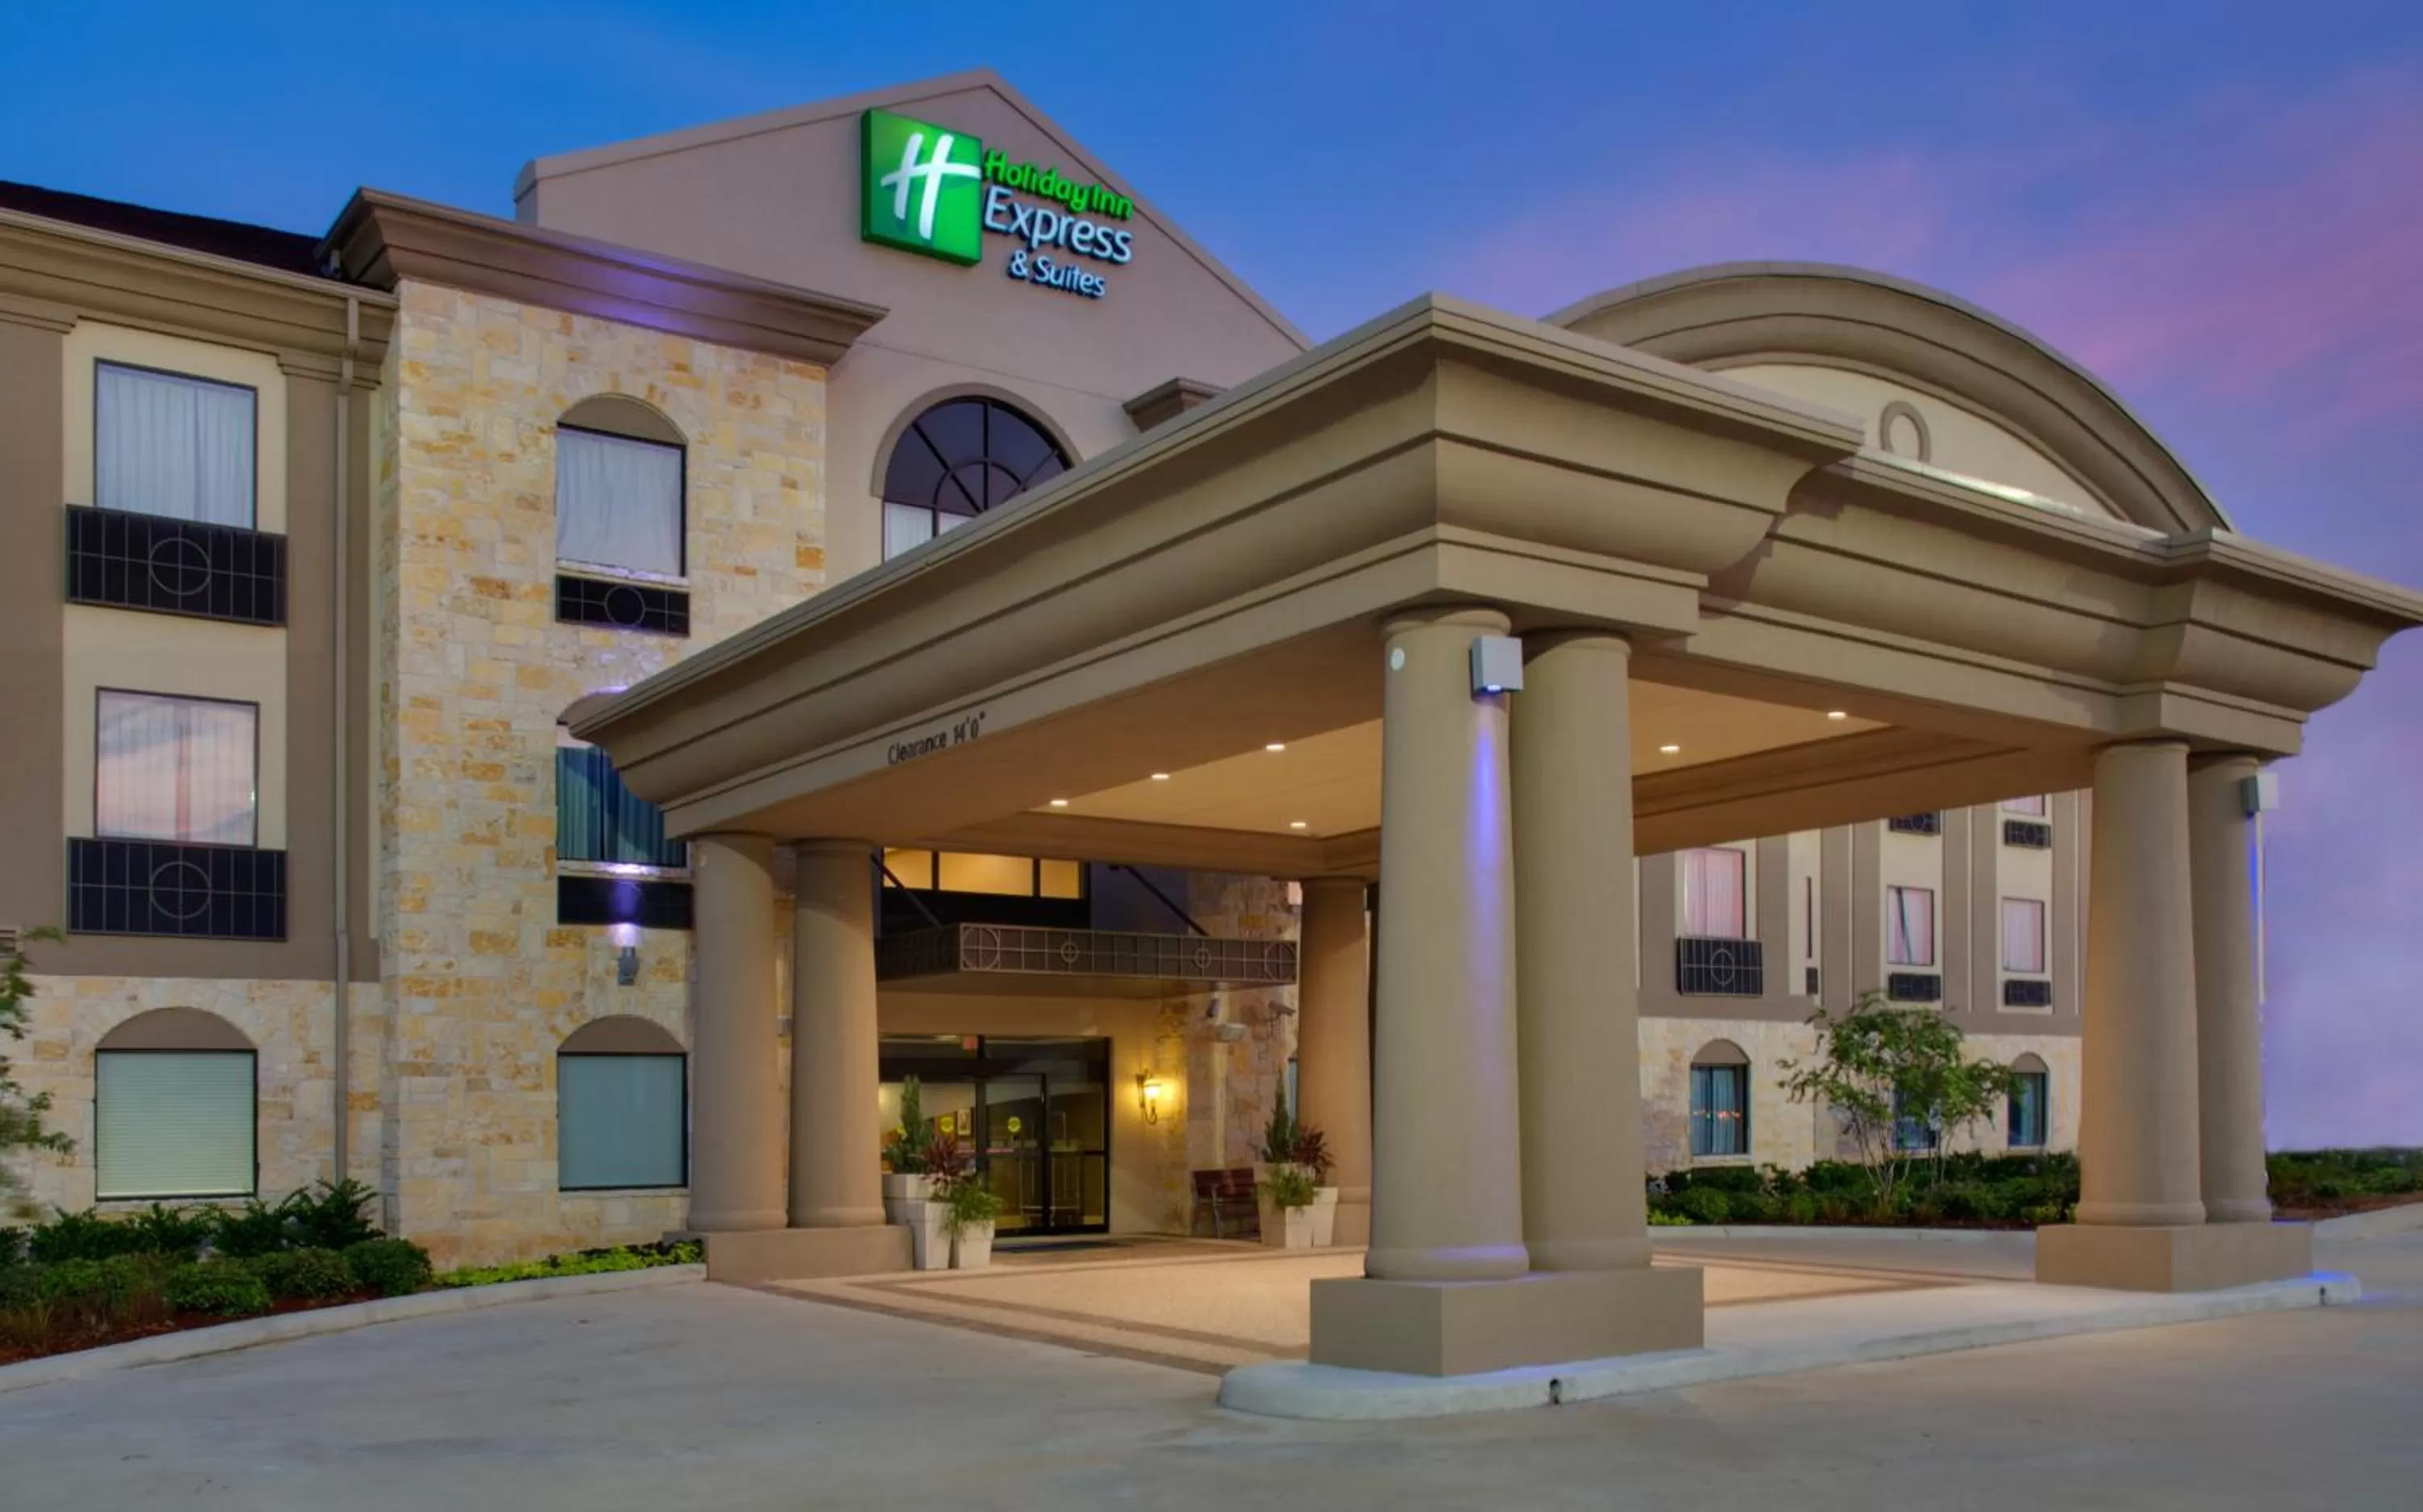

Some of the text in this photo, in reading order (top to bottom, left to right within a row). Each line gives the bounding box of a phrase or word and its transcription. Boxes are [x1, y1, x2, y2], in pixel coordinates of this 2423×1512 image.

[983, 149, 1134, 220] Holiday Inn
[984, 185, 1133, 263] Express
[1008, 250, 1106, 298] & Suites
